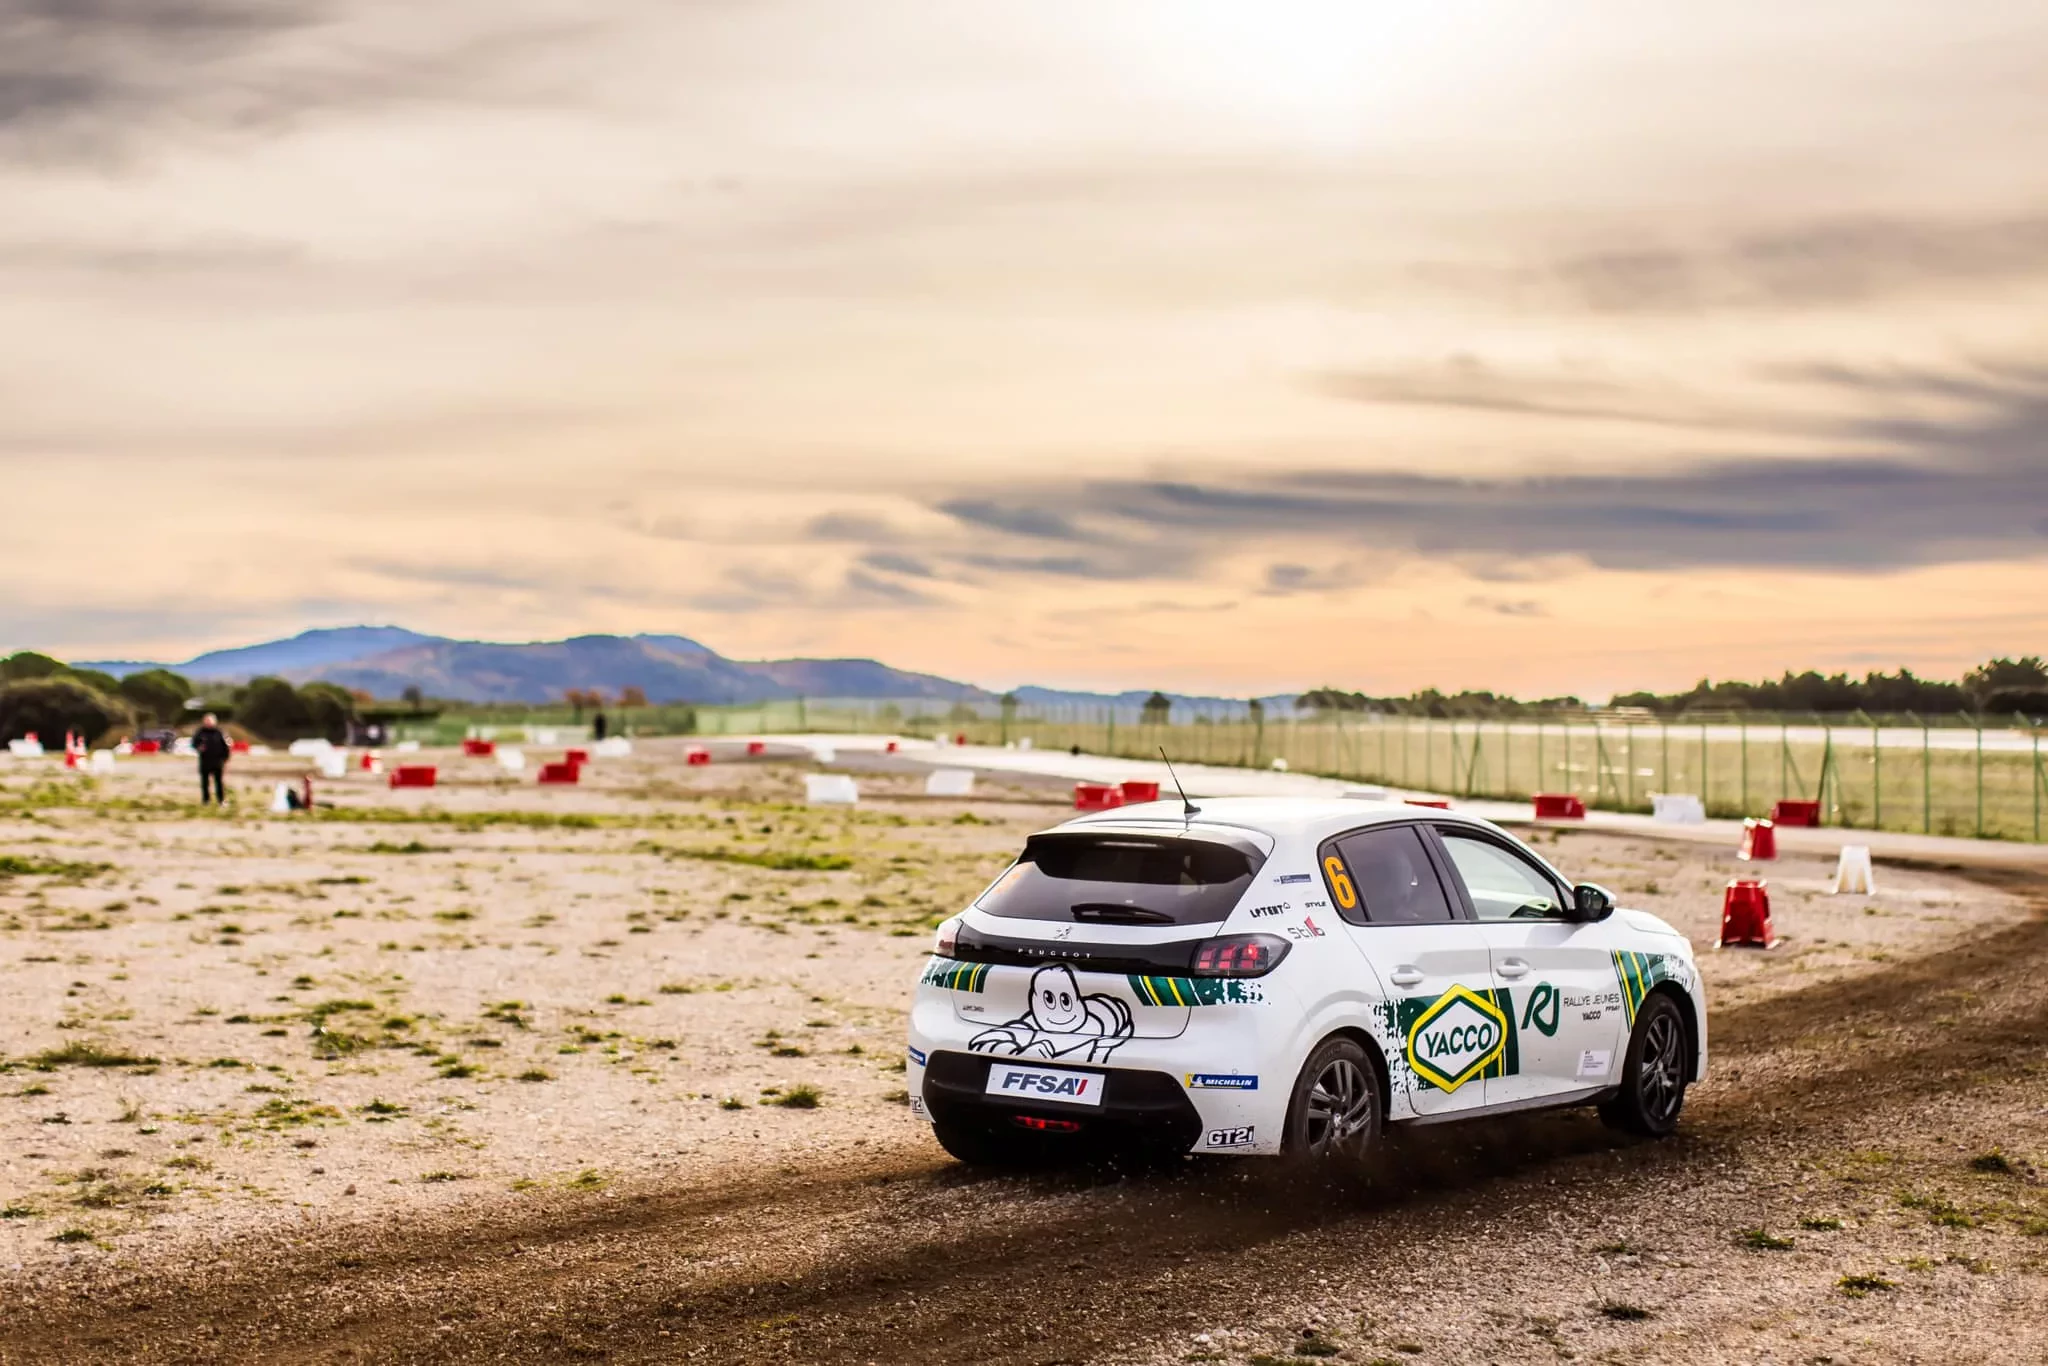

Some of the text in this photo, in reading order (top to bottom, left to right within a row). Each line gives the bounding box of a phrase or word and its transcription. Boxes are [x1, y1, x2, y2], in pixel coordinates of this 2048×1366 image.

[1323, 856, 1356, 909] 6
[1018, 948, 1091, 958] PEUGEOT
[1563, 993, 1620, 1008] RALLYE JEUNES
[1424, 1023, 1493, 1058] YACCO
[1002, 1071, 1077, 1096] FFSA
[1207, 1127, 1254, 1146] GT2i
